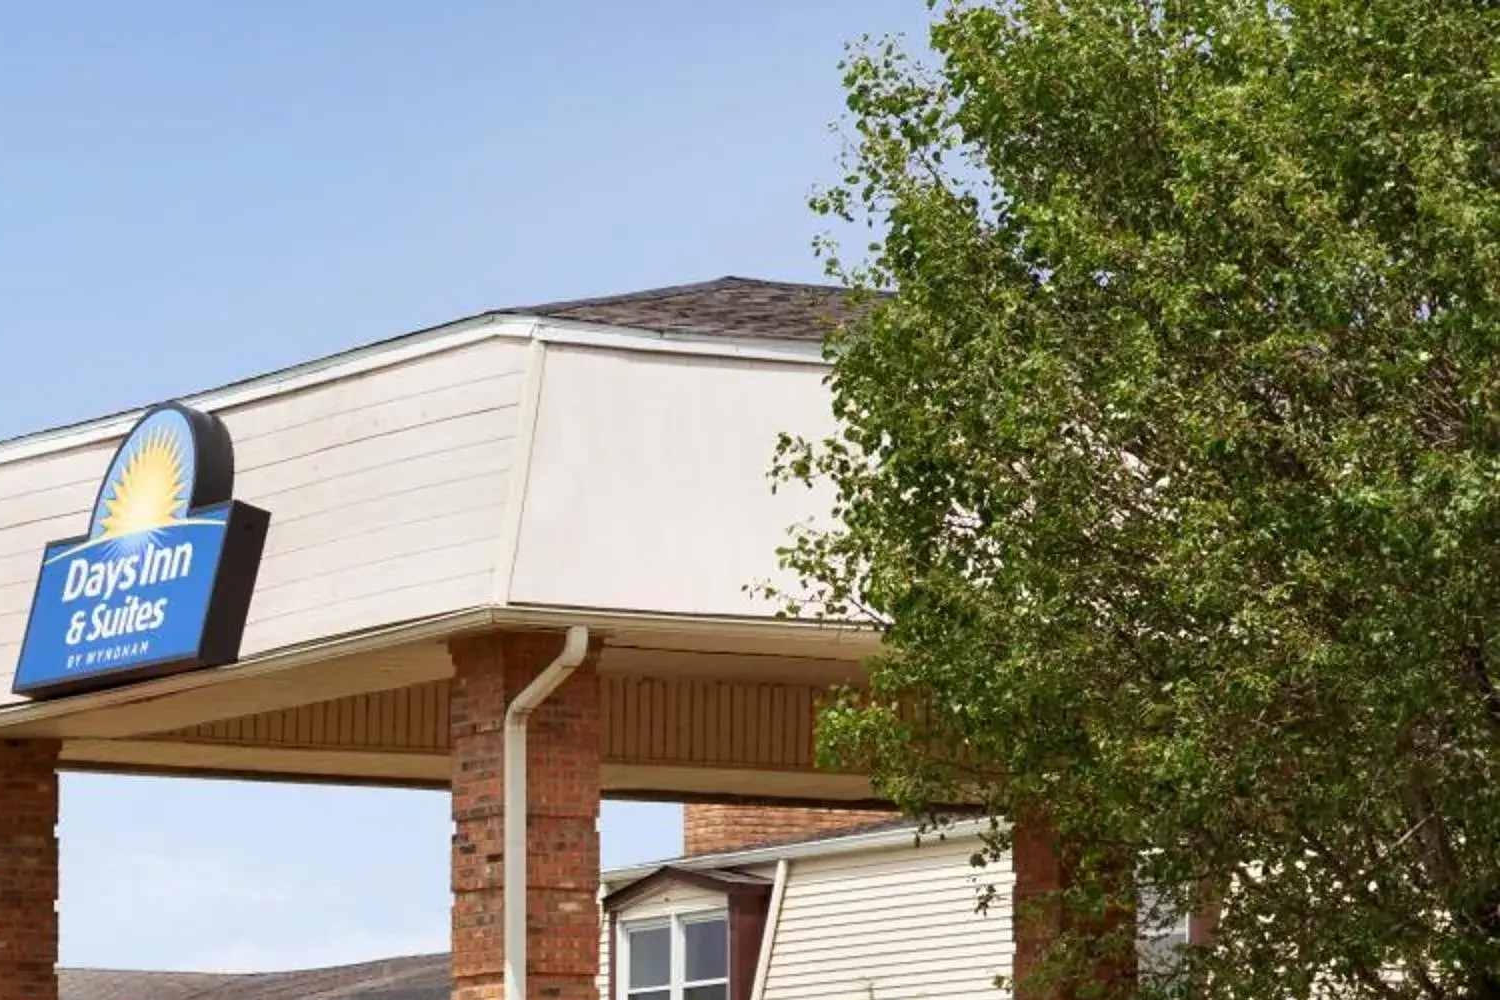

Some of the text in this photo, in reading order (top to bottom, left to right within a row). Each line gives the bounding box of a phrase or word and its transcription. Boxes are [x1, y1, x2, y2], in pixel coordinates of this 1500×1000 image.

[62, 542, 193, 602] Days Inn
[65, 595, 168, 645] & Suites
[67, 653, 82, 669] BY
